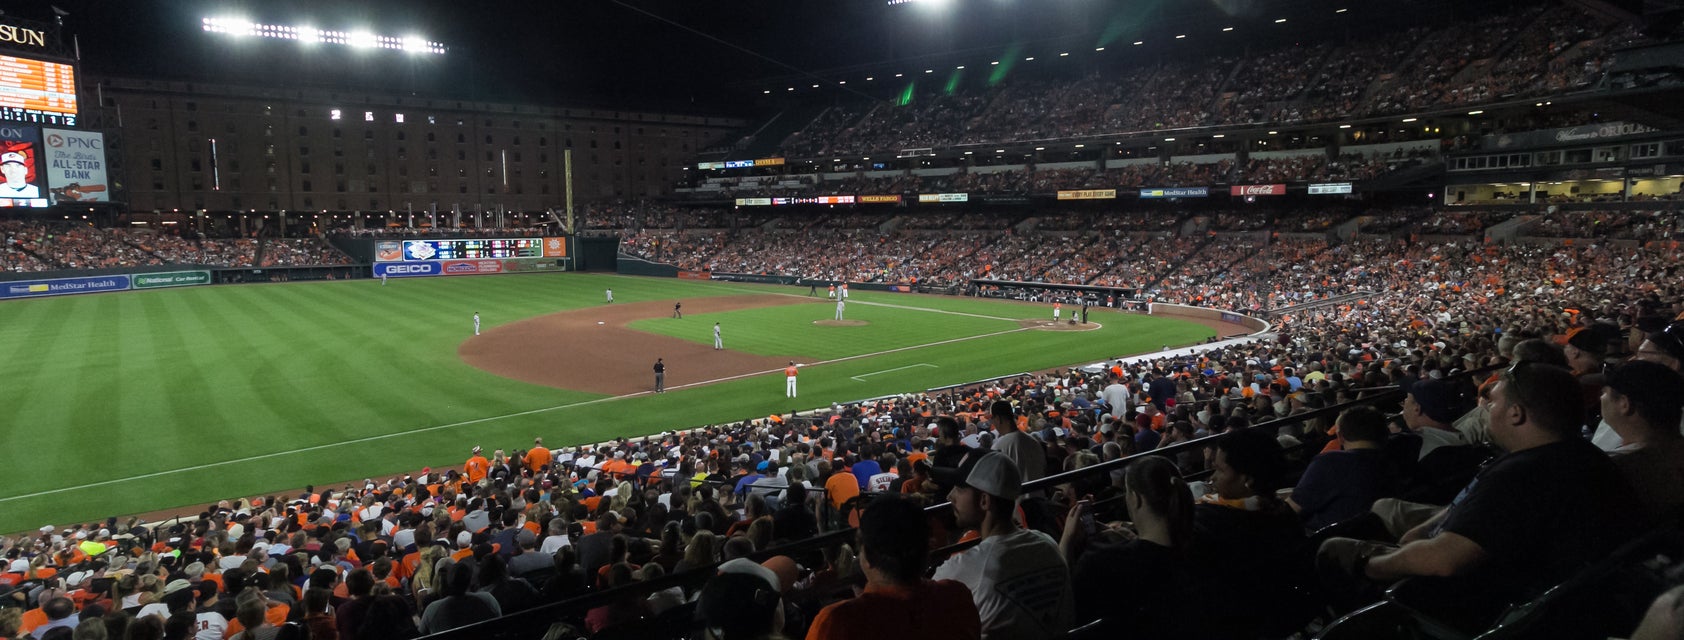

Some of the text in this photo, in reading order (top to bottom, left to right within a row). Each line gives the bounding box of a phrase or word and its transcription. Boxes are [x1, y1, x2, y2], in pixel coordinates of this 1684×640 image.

[0, 24, 45, 47] SUN
[31, 114, 37, 122] 1
[50, 116, 56, 124] 1
[66, 117, 75, 126] 2
[67, 137, 101, 149] PNC
[53, 160, 100, 170] ALL-STAR
[64, 169, 91, 179] BANK
[385, 264, 432, 274] GEICO
[50, 280, 116, 291] MedStar Health
